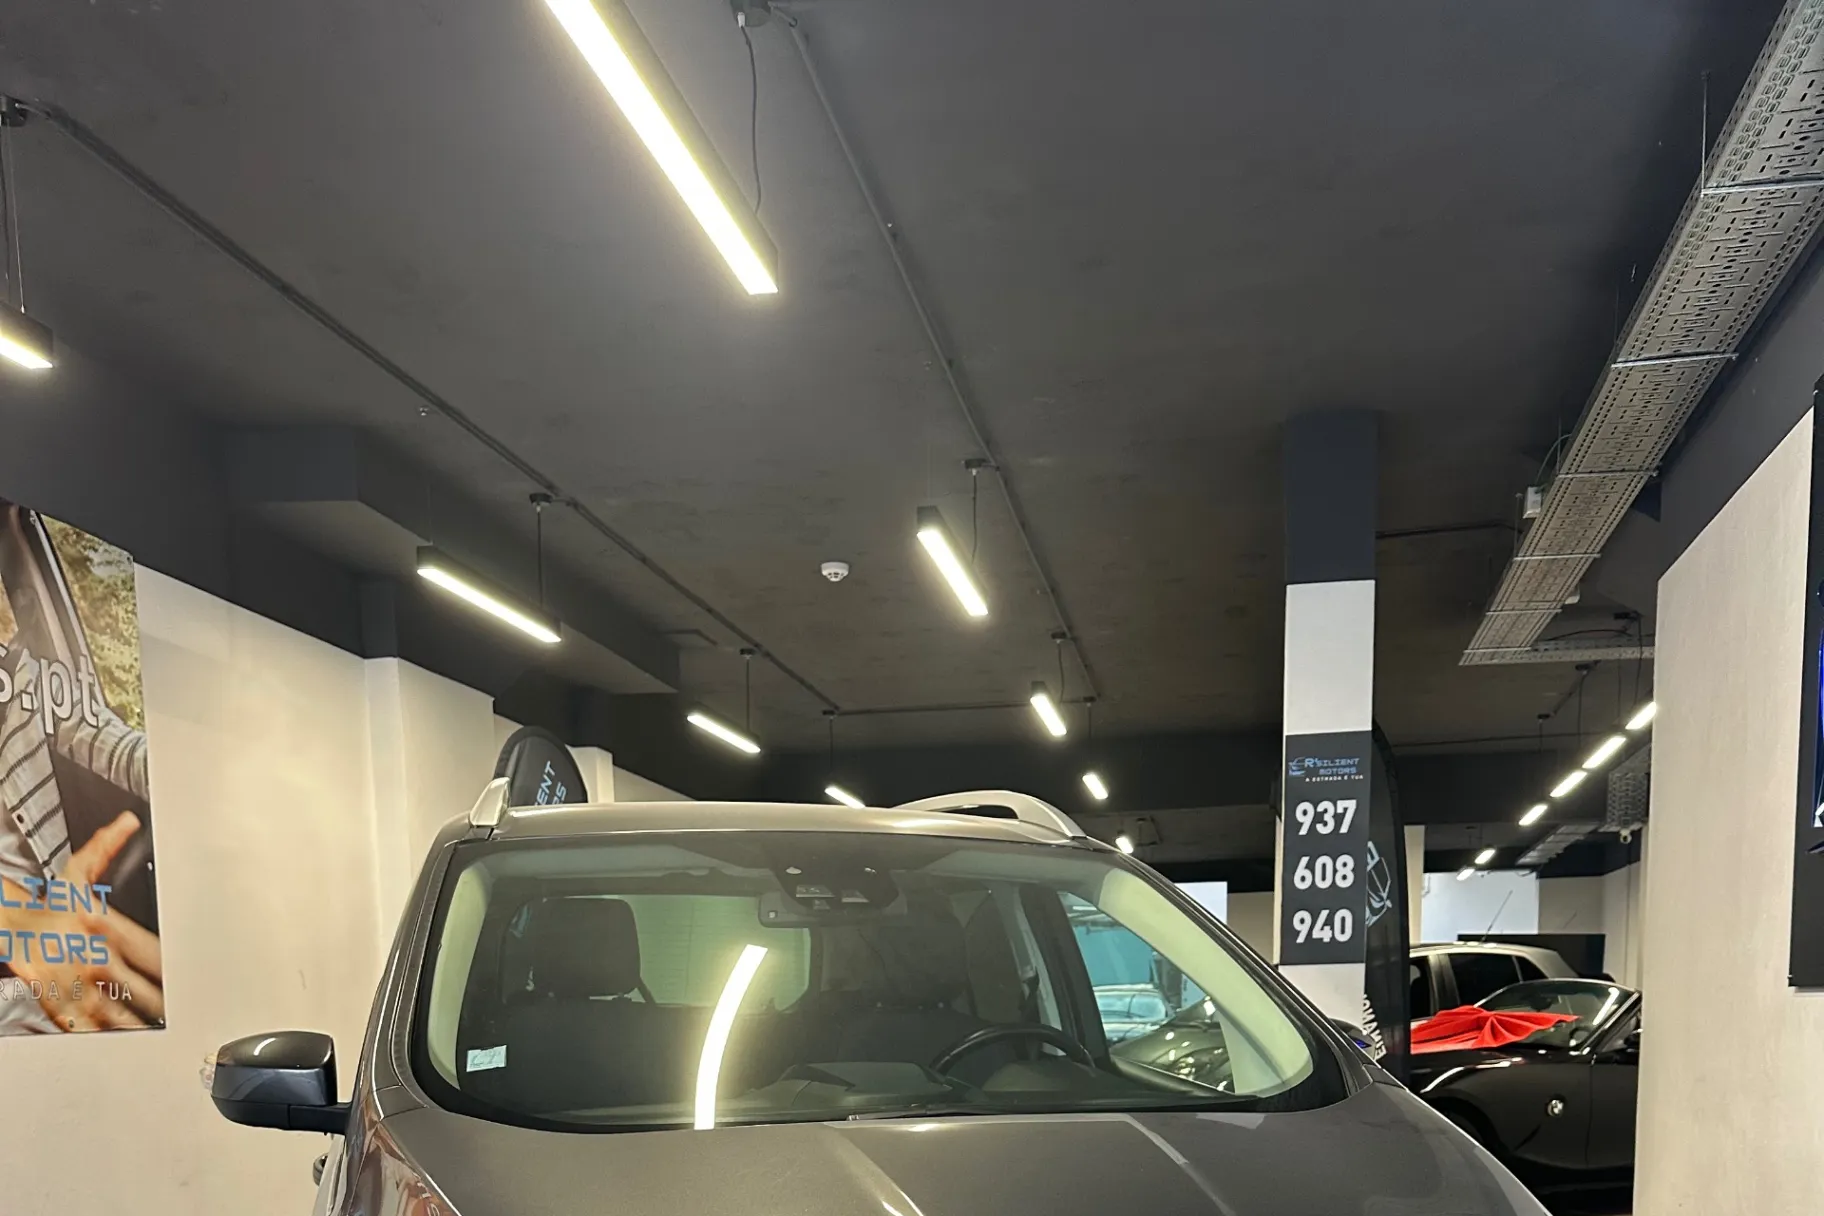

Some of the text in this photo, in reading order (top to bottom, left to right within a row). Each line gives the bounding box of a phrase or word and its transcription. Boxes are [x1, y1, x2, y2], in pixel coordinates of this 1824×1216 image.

[1319, 766, 1357, 775] MOTORS
[1295, 799, 1357, 836] 937
[1293, 854, 1355, 890] 608
[1292, 908, 1353, 944] 940
[73, 975, 84, 1000] É
[96, 981, 132, 1001] TUA
